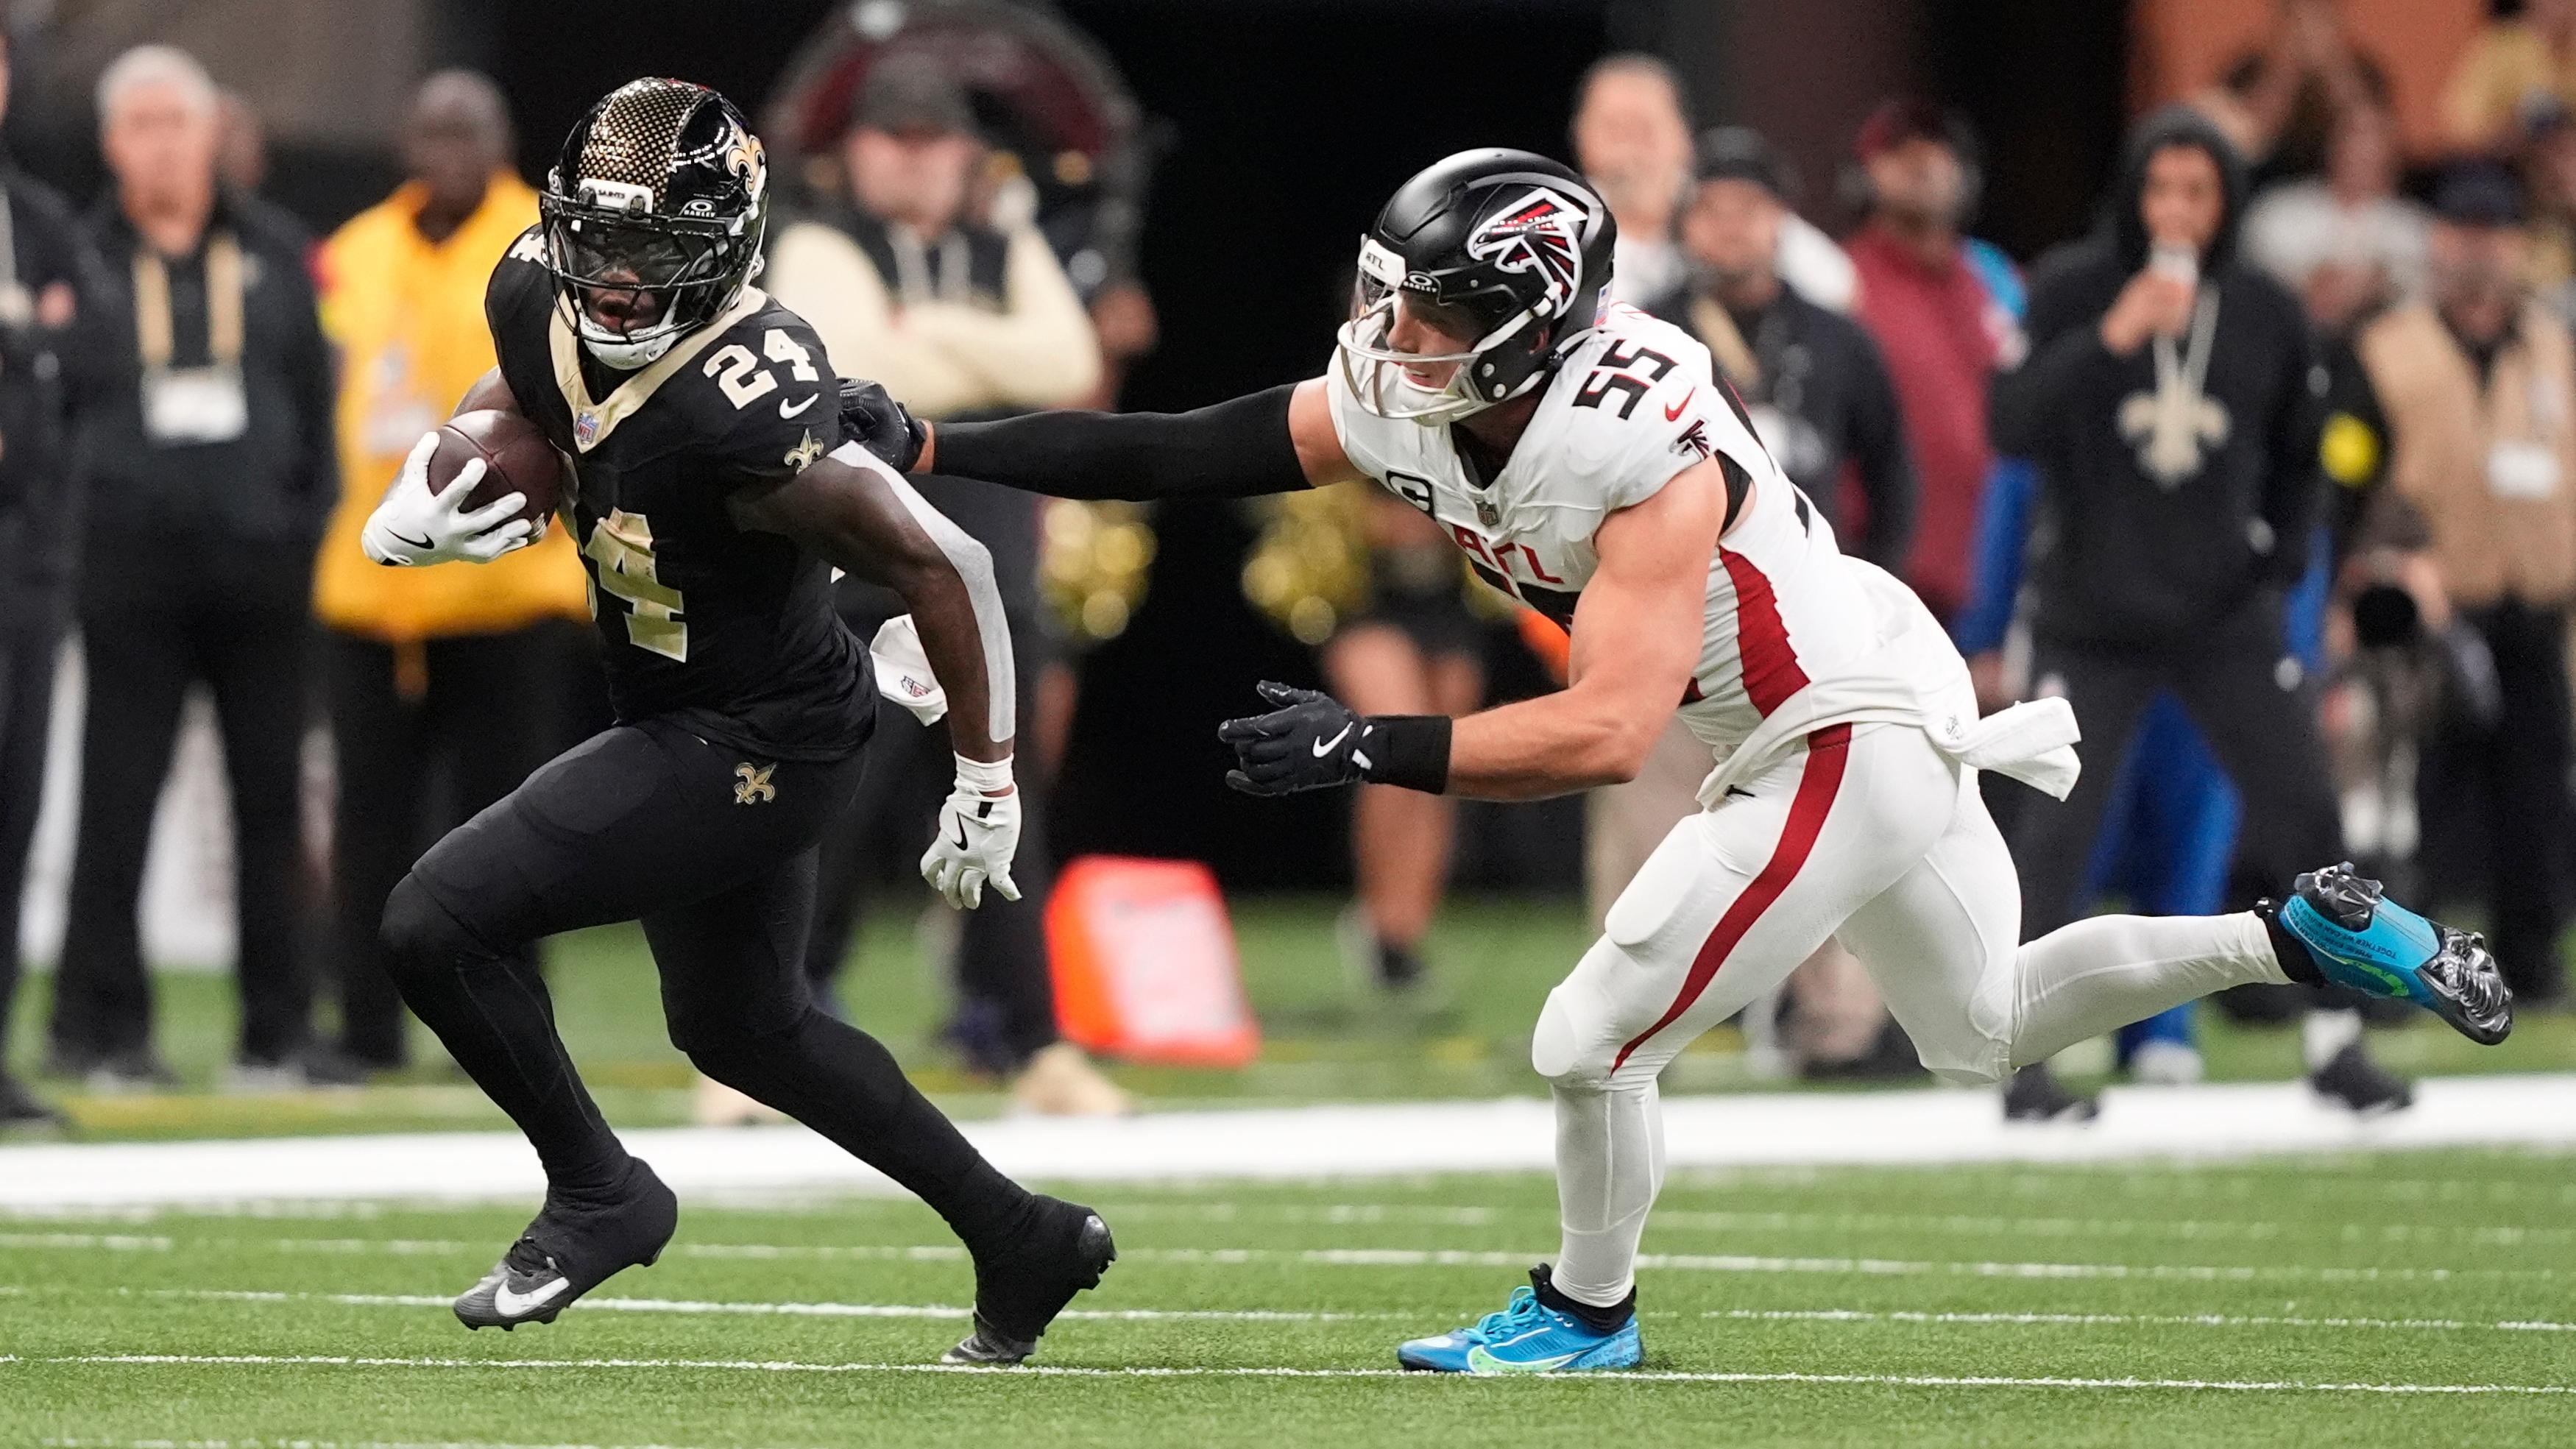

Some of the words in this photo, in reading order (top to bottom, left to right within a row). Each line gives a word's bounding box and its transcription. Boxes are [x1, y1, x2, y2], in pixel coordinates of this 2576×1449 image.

[598, 189, 625, 199] SAINTS
[684, 209, 716, 218] OAKLEY
[1365, 252, 1384, 272] ATL
[1403, 281, 1437, 293] OAKLEY
[702, 328, 820, 411] 24
[1571, 338, 1680, 421] 55
[1453, 523, 1565, 584] ATL
[585, 506, 688, 664] 4
